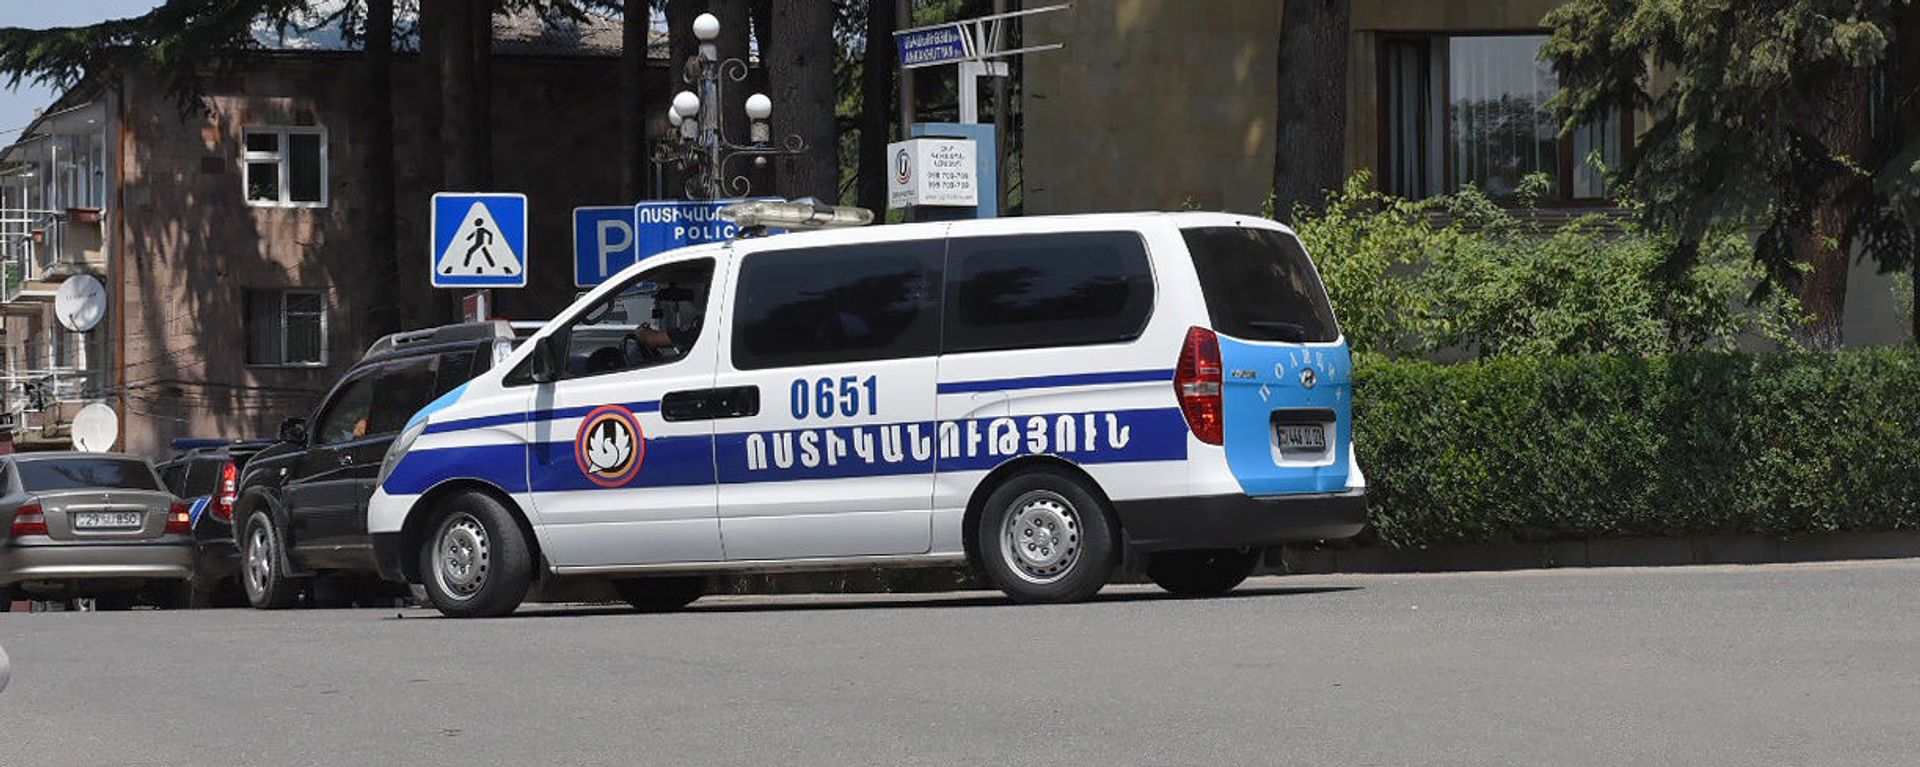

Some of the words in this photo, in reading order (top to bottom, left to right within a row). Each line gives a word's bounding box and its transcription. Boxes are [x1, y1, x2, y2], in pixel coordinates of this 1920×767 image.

[597, 220, 633, 276] P
[674, 225, 744, 240] POLIC
[791, 374, 877, 420] 0651
[746, 413, 1130, 470] ՈՍՏԻԿԱՆՈՒԹՅՈՒՆ
